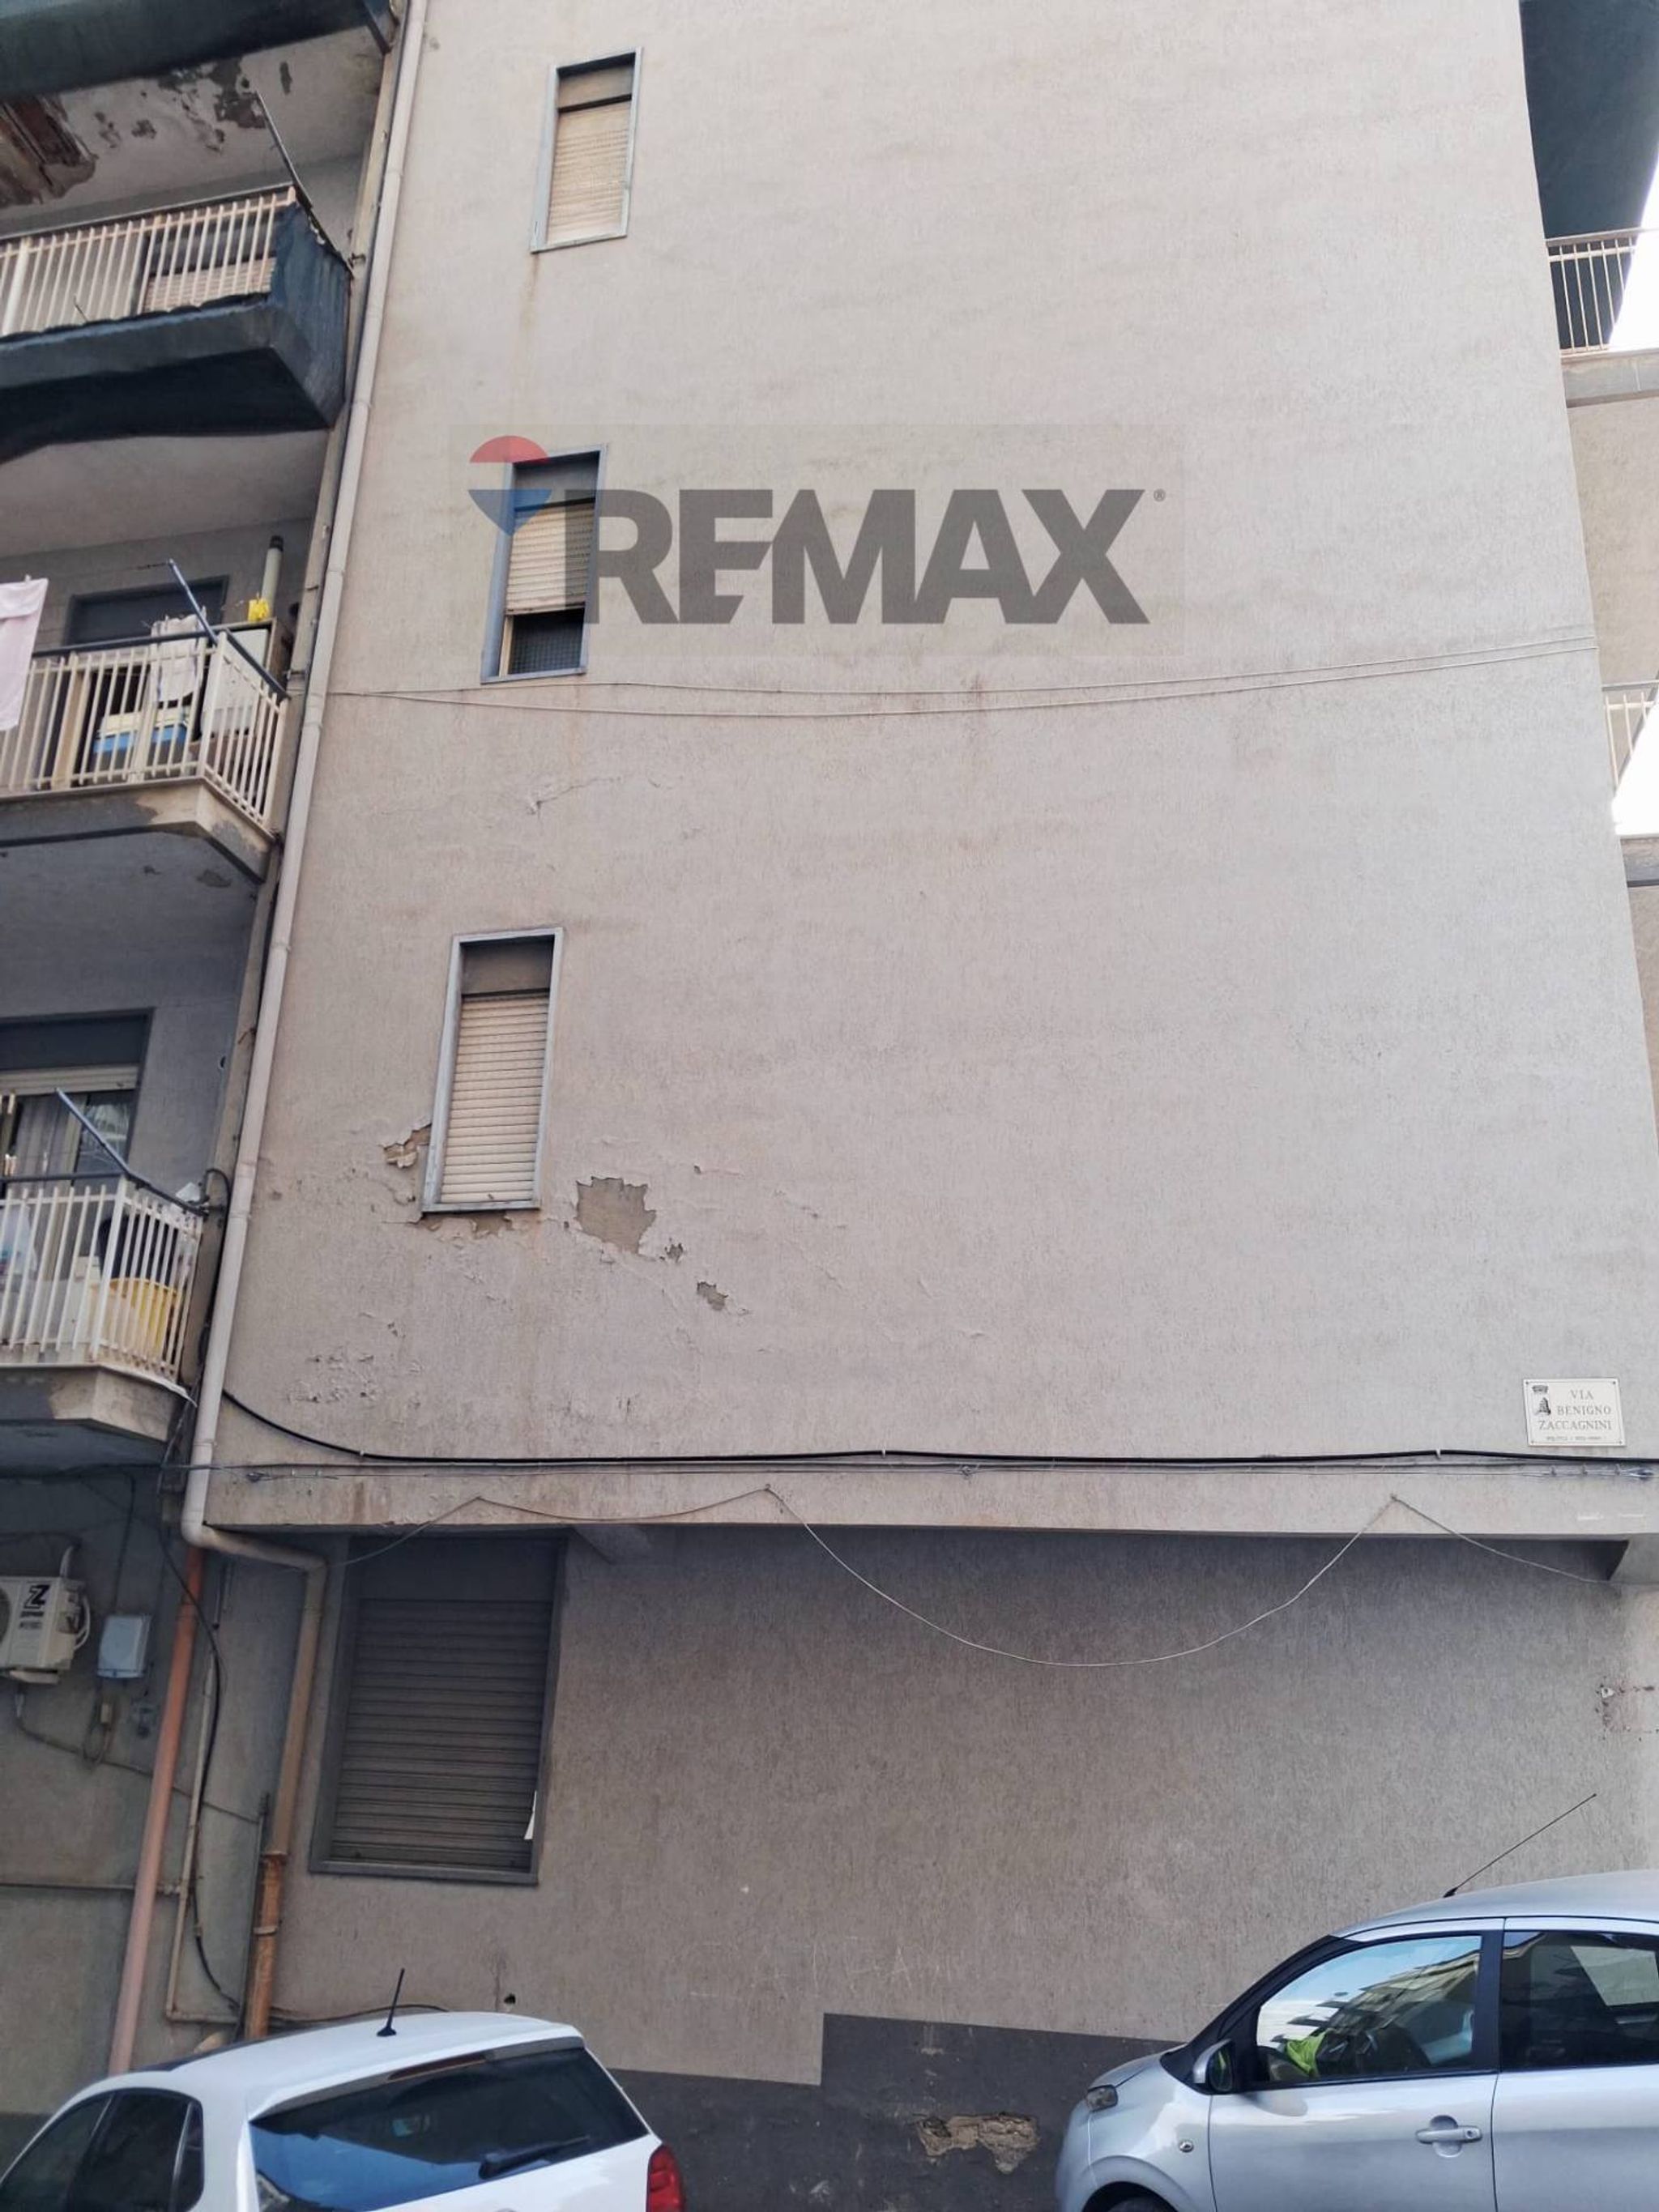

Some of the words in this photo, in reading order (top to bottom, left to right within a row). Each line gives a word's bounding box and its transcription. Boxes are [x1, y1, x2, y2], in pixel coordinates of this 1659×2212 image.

[1570, 1389, 1593, 1400] VIA
[1556, 1405, 1612, 1416] BENIGNO
[1538, 1420, 1613, 1430] ZACCAGNINI
